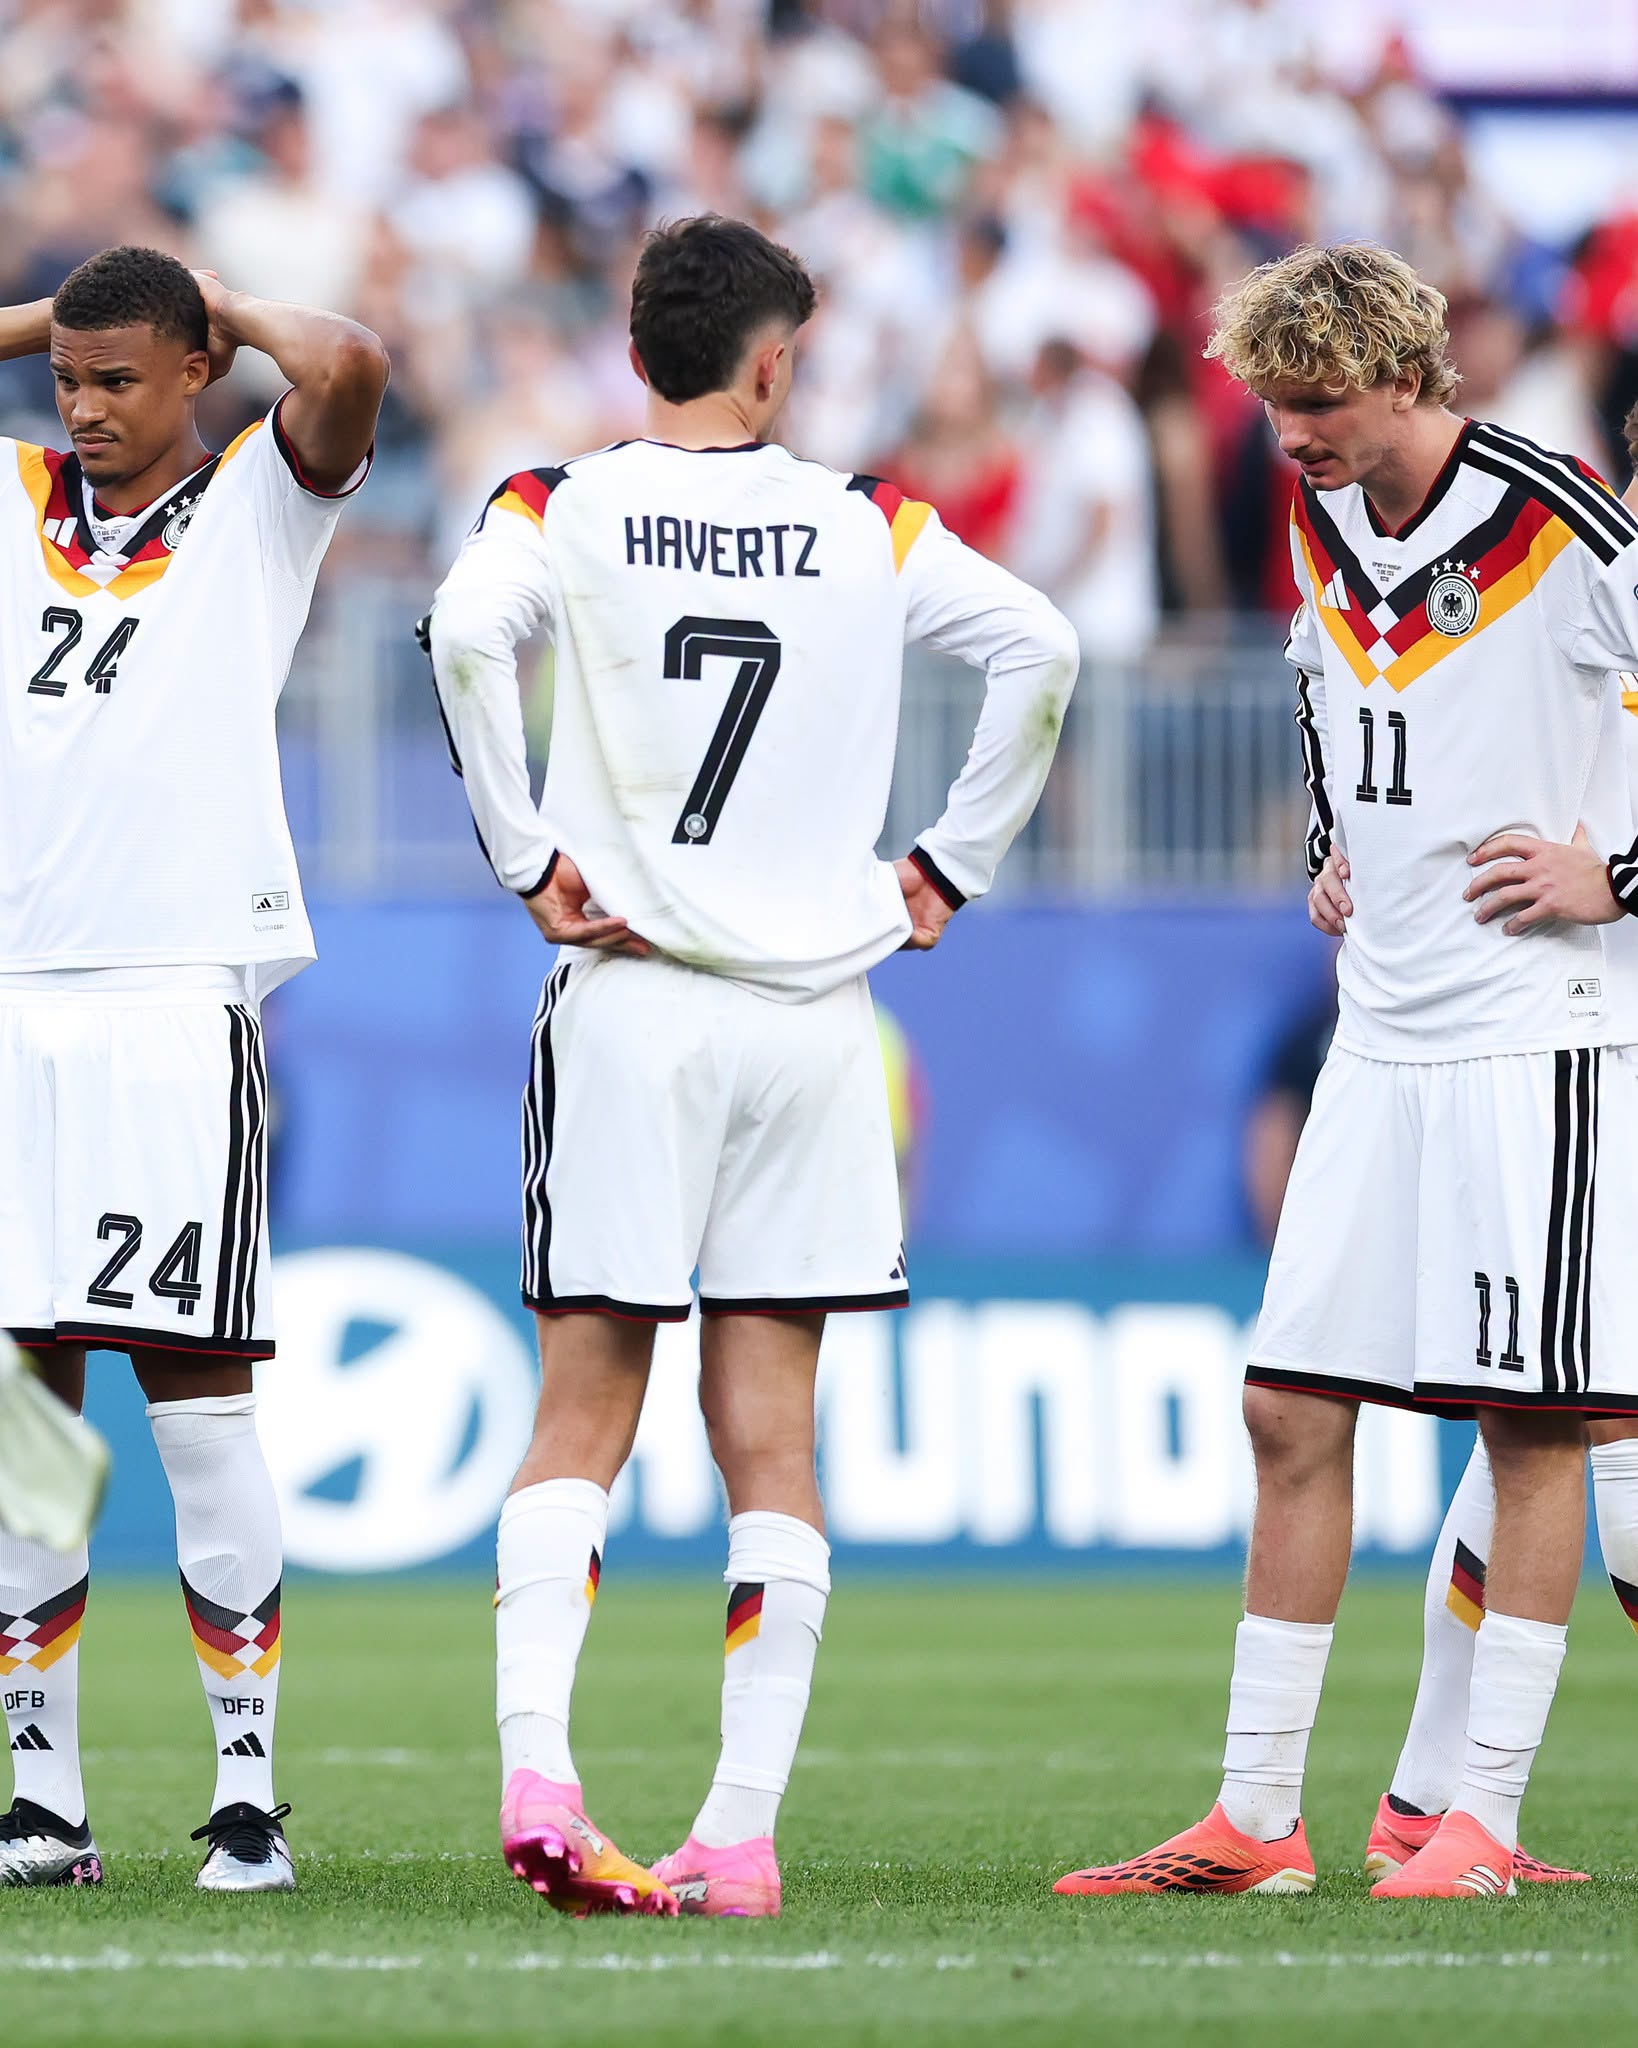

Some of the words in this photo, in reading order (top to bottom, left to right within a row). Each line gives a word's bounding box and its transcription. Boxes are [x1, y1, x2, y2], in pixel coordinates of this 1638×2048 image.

[625, 515, 820, 578] HAVERTZ
[27, 605, 140, 698] 24
[663, 615, 781, 846] 7
[1356, 707, 1412, 806] 11
[86, 1212, 203, 1316] 24
[1474, 1271, 1525, 1373] 11
[4, 1690, 45, 1711] DFB
[221, 1697, 264, 1716] DFB
